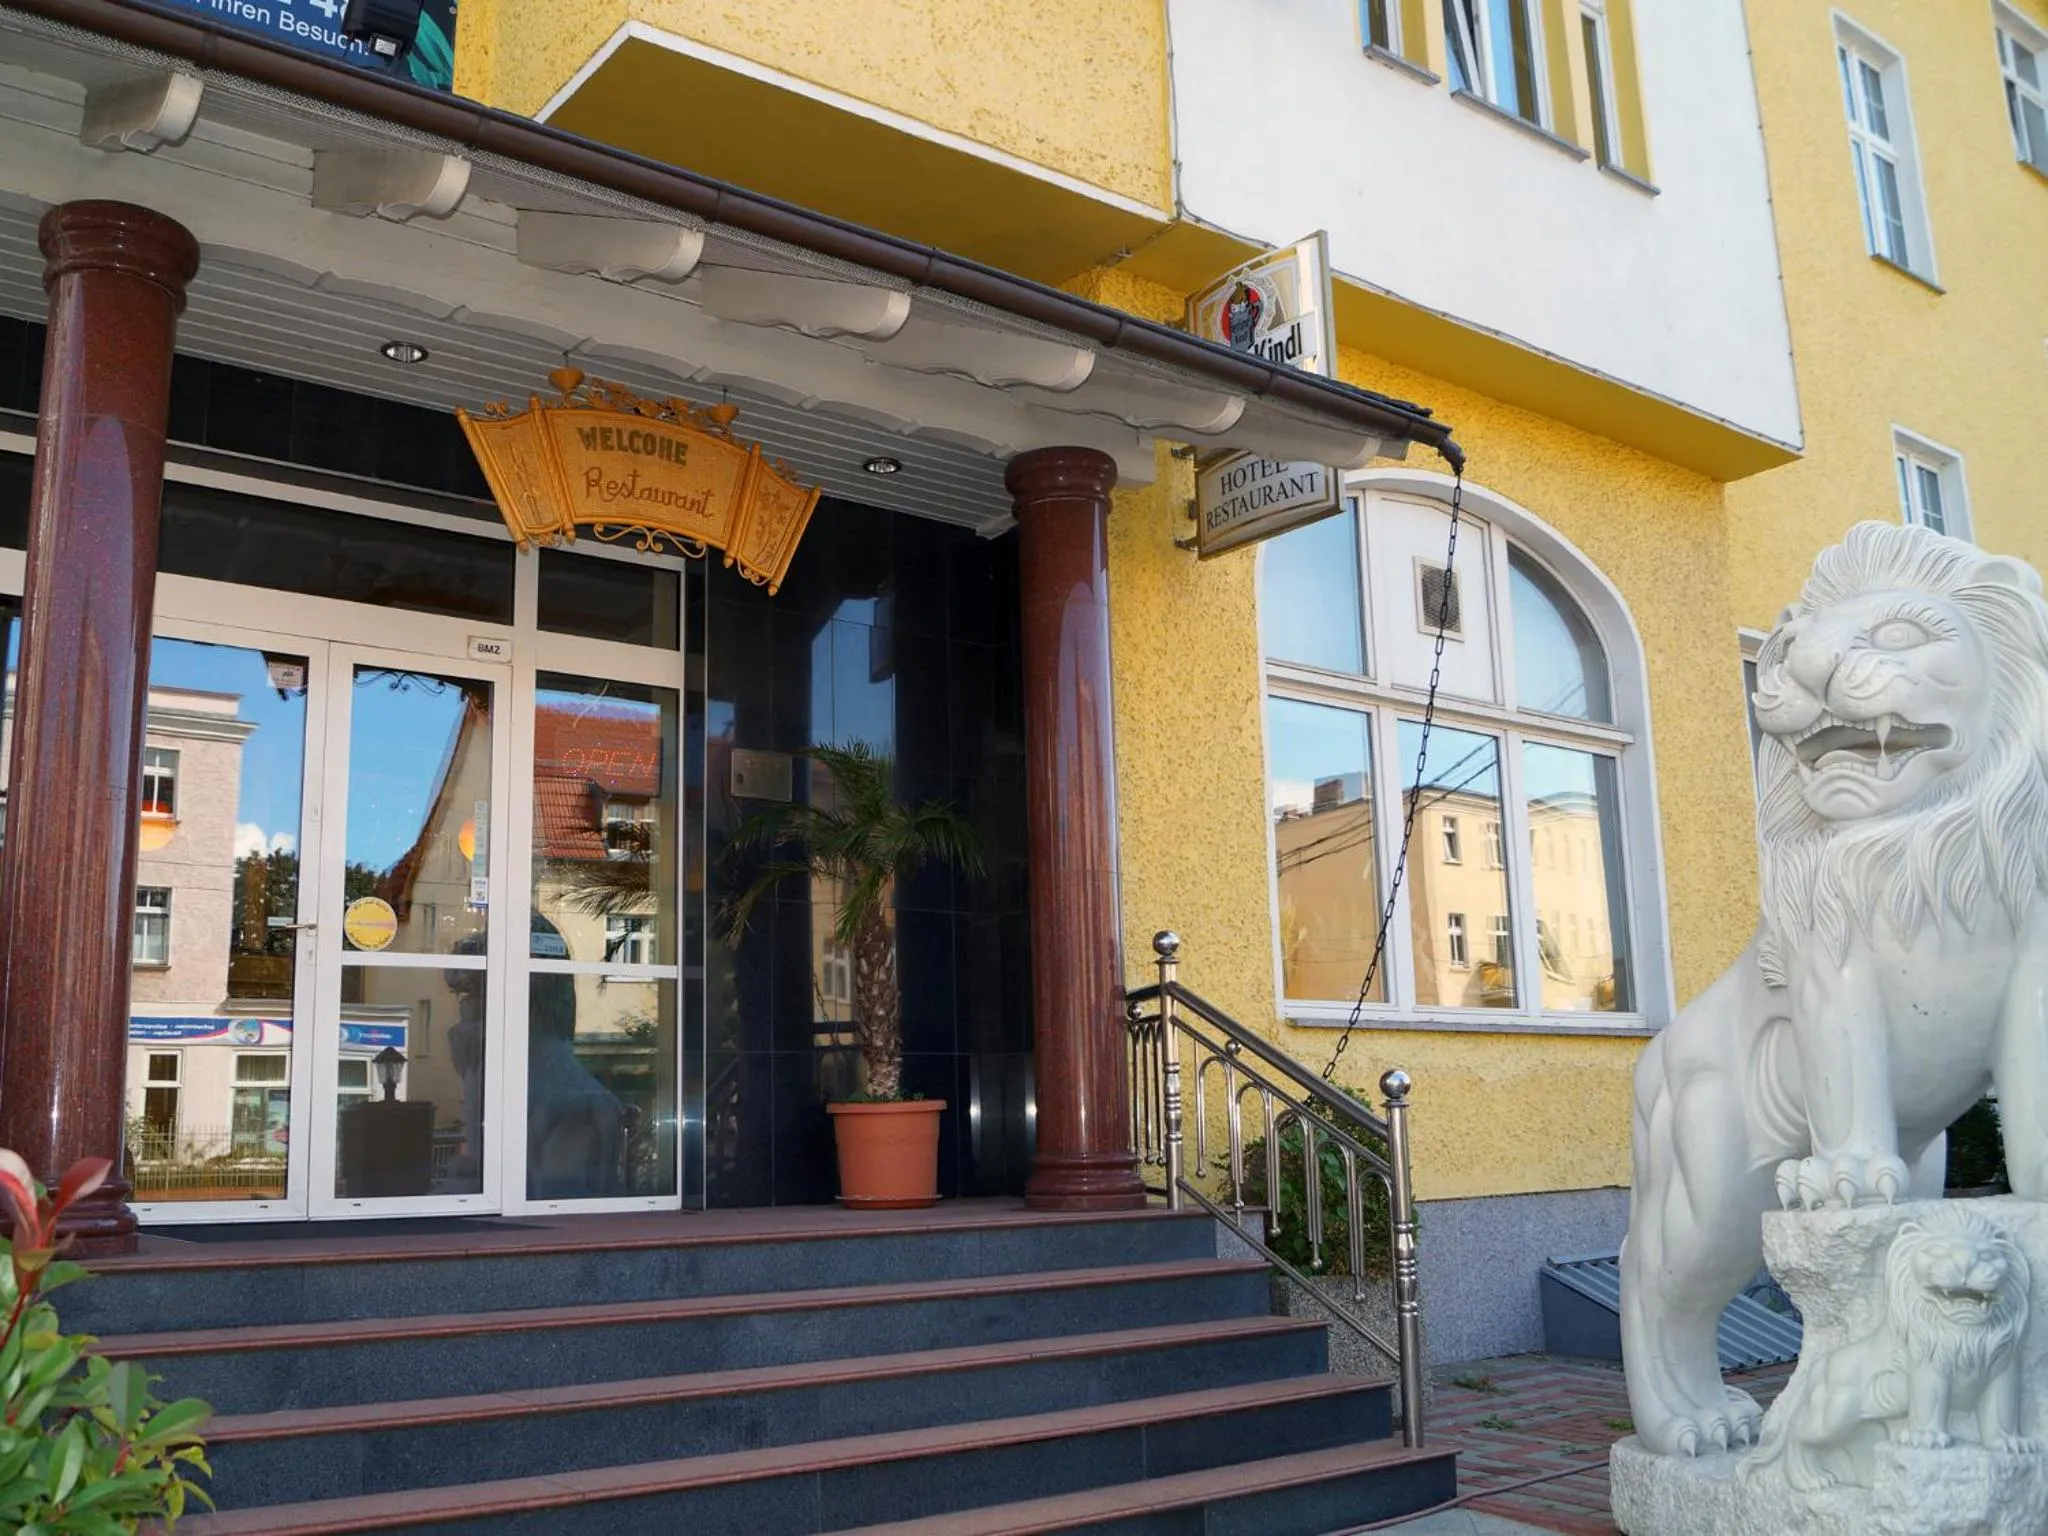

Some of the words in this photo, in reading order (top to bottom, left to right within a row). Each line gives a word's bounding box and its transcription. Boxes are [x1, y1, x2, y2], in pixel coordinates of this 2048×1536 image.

[576, 426, 689, 466] WELCOME
[580, 466, 714, 518] Restaurant
[1220, 459, 1289, 497] HOTEL
[1206, 472, 1320, 533] RESTAURANT
[560, 747, 656, 777] OPEN
